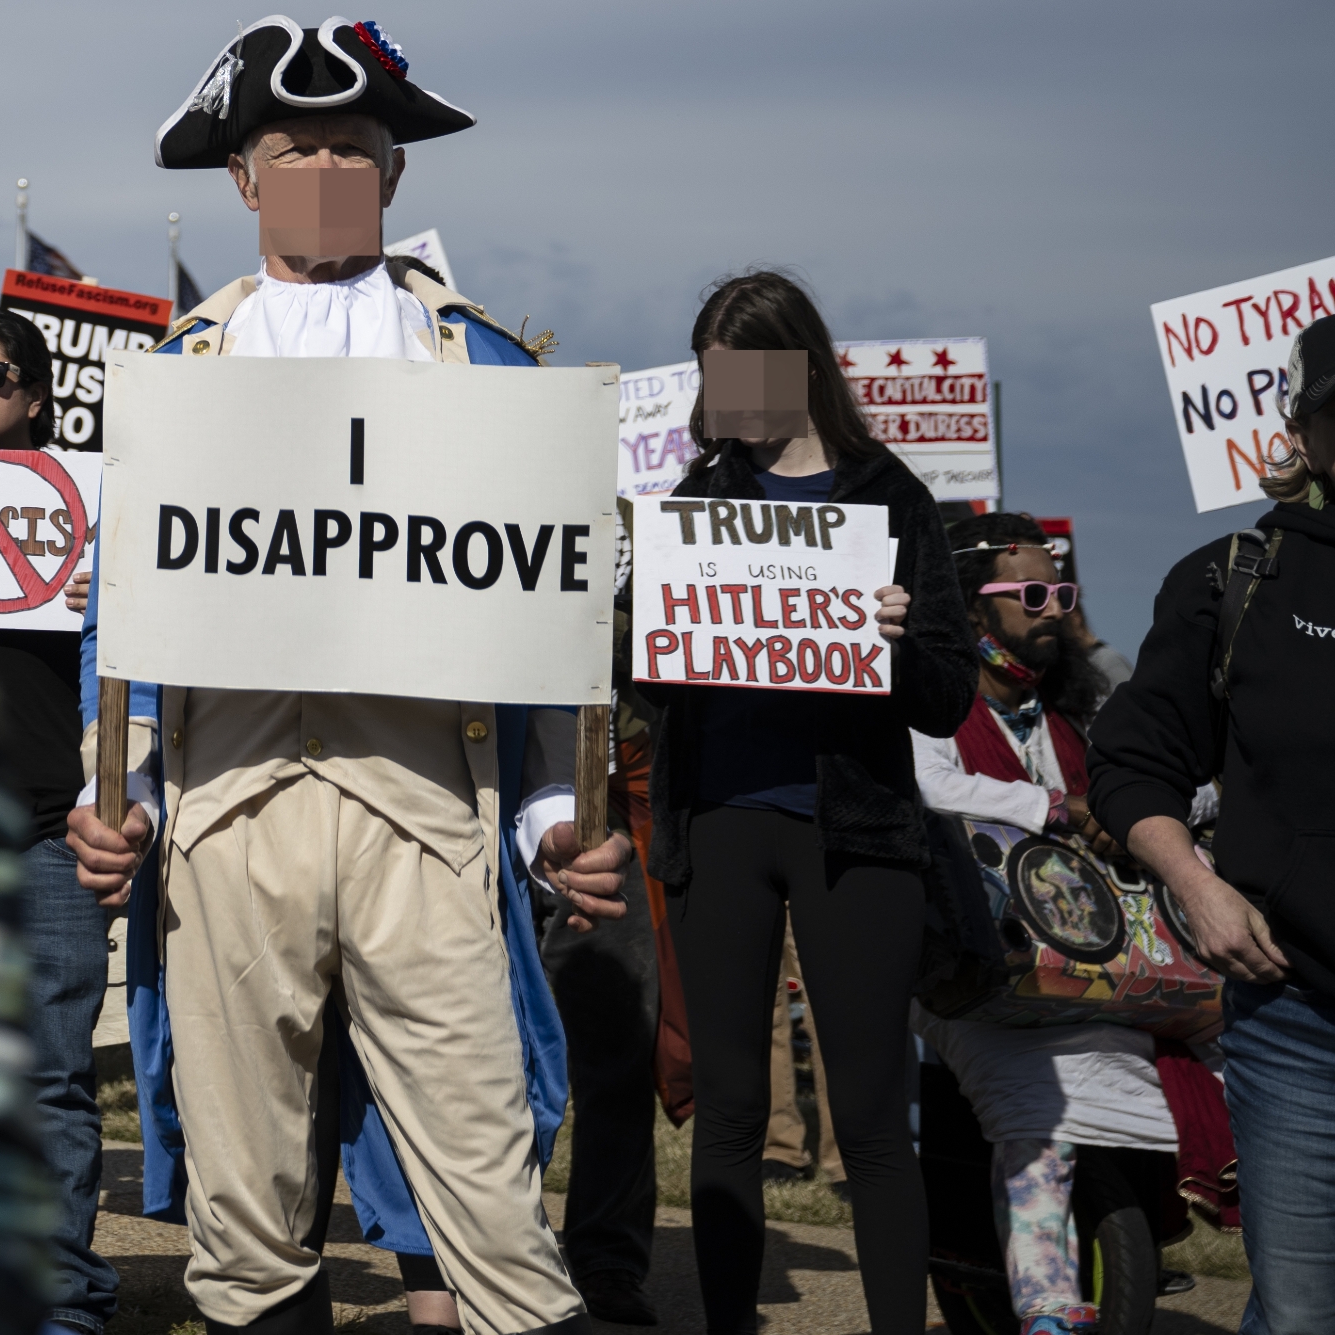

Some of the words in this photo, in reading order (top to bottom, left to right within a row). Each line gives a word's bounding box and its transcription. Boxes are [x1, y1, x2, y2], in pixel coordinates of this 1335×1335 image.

[15, 273, 160, 316] RefuseFascism.org
[1163, 312, 1219, 367] NO
[1221, 276, 1335, 347] TYRA
[619, 376, 666, 403] TED
[871, 377, 940, 404] CAPITAL
[941, 376, 986, 402] CITY
[1182, 383, 1239, 434] NO
[350, 418, 365, 485] I
[869, 415, 904, 441] ER
[904, 413, 987, 441] DURESS
[156, 504, 591, 593] DISAPPROVE
[660, 500, 846, 550] TRUMP
[698, 562, 717, 578] IS
[748, 564, 818, 581] USING
[661, 582, 867, 631] HITLER'S
[645, 628, 884, 688] PLAYBOOK
